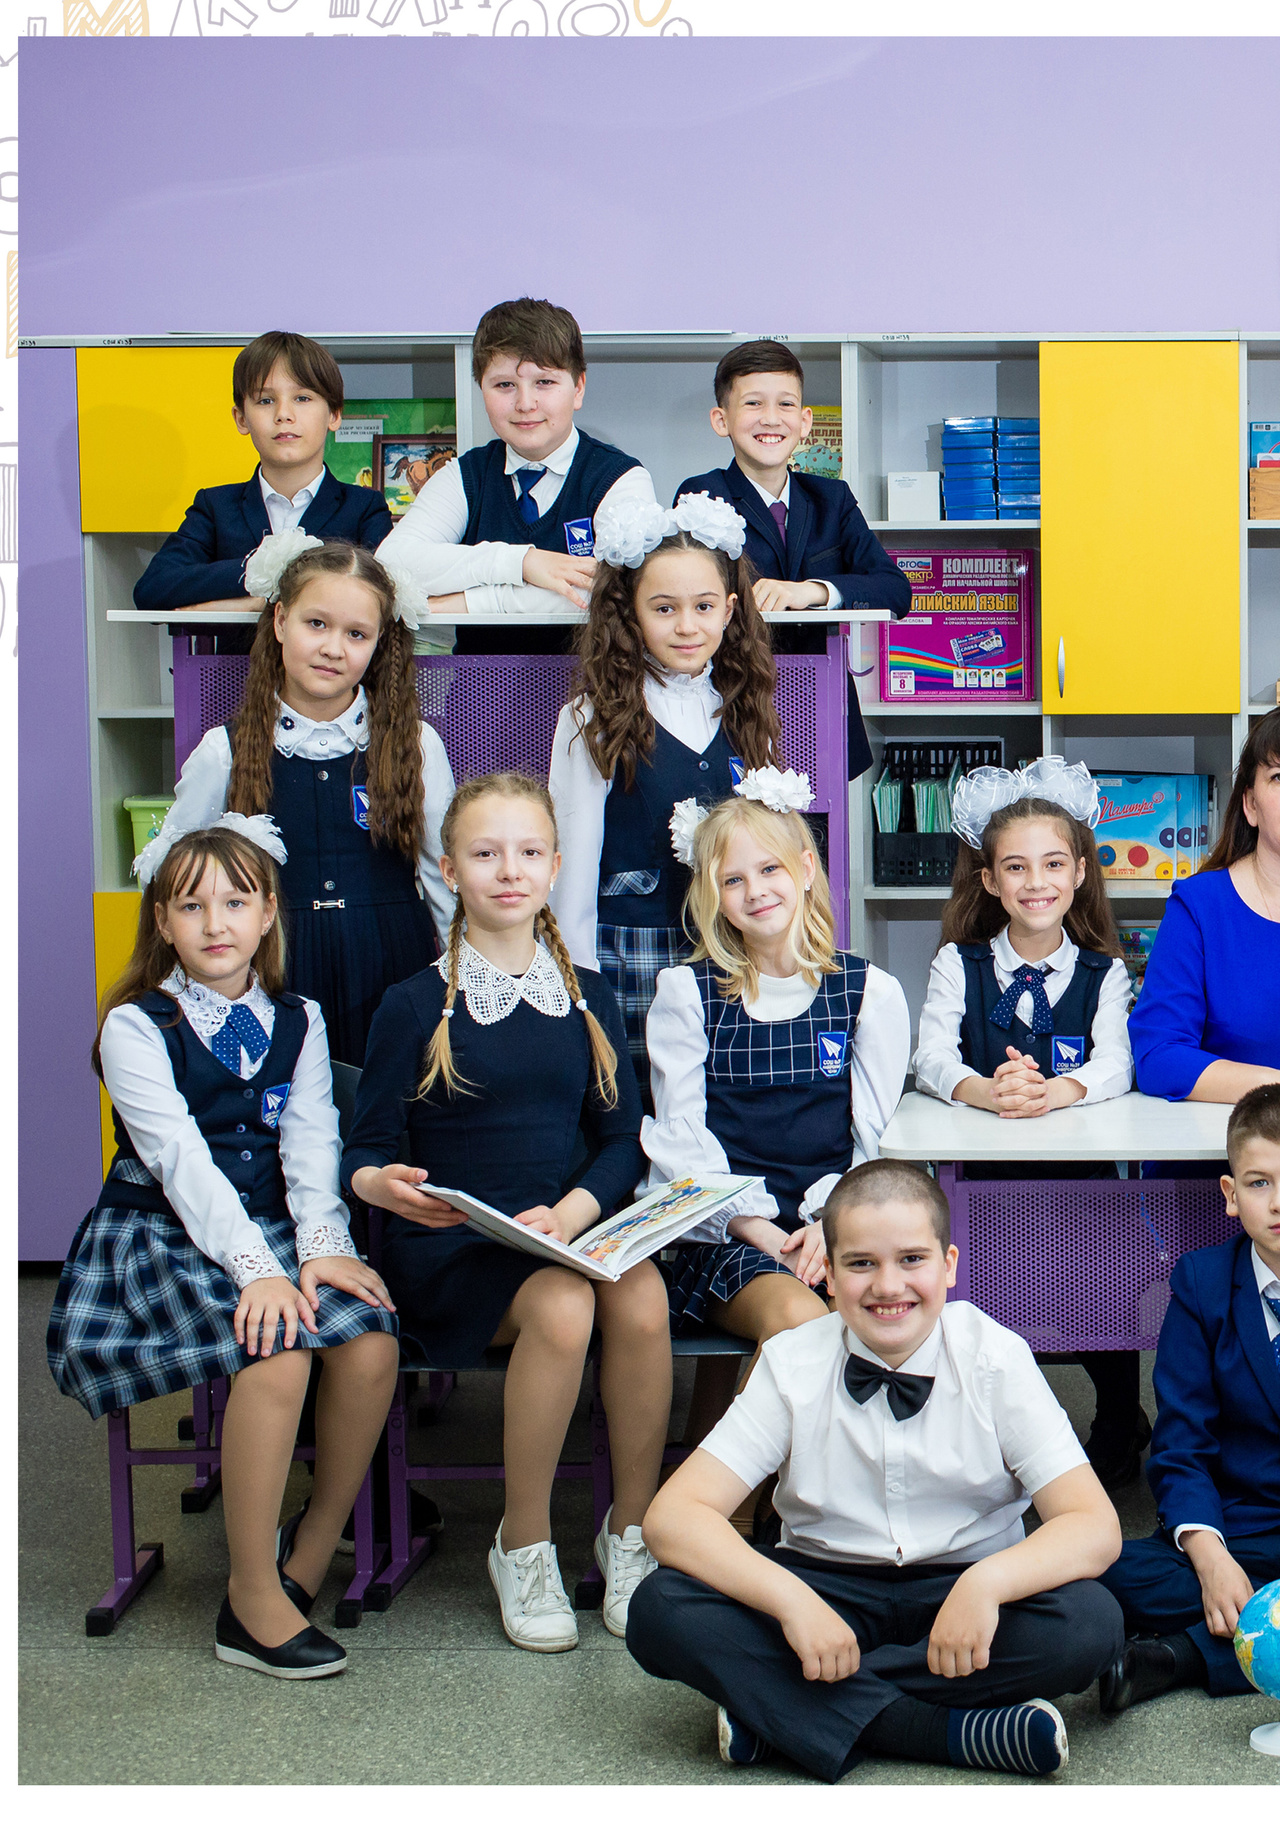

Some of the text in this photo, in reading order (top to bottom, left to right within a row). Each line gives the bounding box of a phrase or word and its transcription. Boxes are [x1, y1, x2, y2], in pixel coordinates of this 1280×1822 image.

[943, 558, 1019, 574] КОМПЛЕКТ
[942, 579, 956, 587] ДЛЯ
[957, 577, 993, 587] НАЧАЛЬНОЙ
[911, 590, 1018, 612] ГЛИЙСКИЙ ЯЗЫК
[899, 679, 906, 689] 8
